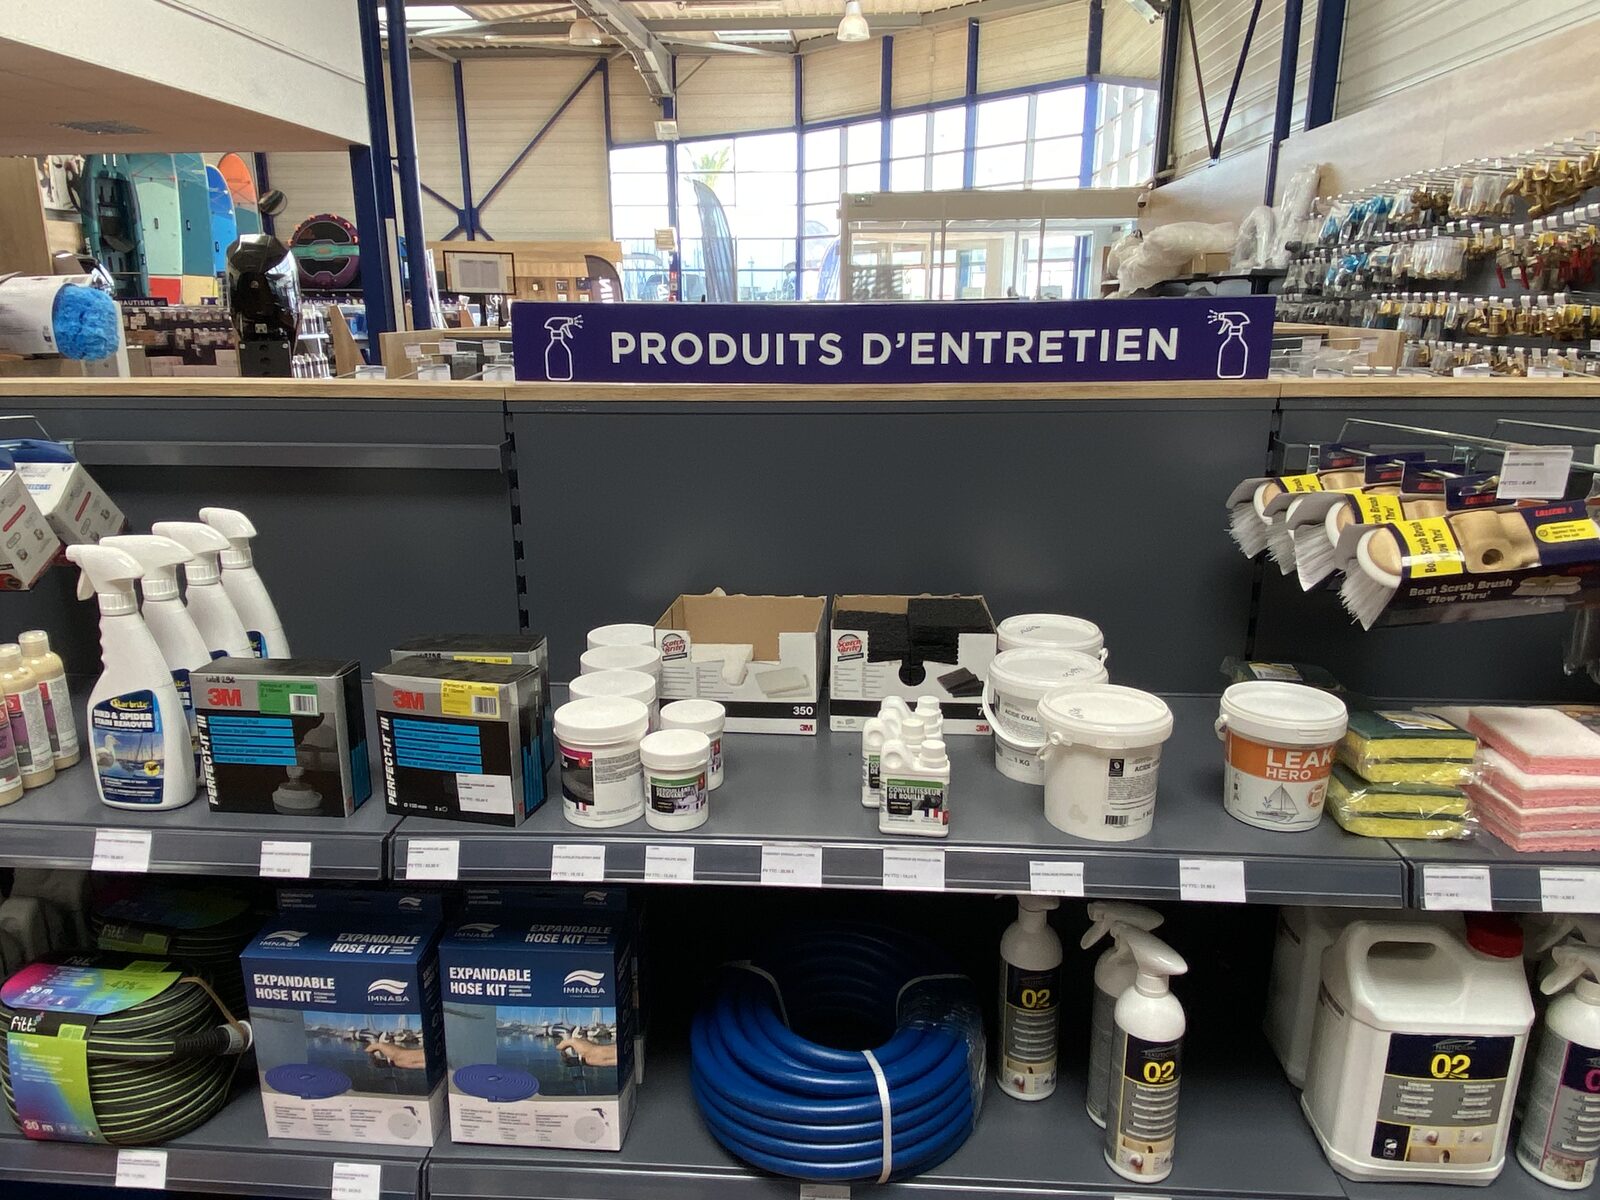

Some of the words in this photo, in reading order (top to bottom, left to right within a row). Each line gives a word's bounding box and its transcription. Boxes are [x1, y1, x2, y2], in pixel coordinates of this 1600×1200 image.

[610, 331, 842, 367] PRODUITS
[862, 327, 1180, 366] D'ENTRETIEN
[1409, 586, 1437, 597] Boat
[1440, 582, 1475, 593] Scrub
[1477, 578, 1513, 589] Brush
[208, 687, 242, 707] 3M
[393, 690, 425, 711] 3M
[119, 712, 152, 720] SPIDER
[793, 706, 813, 715] 350
[113, 720, 153, 728] REMOVER
[976, 724, 989, 732] 3M
[199, 728, 219, 806] PERFECT-IT
[382, 732, 398, 806] PERFECT-IT
[1019, 759, 1030, 767] KG
[1266, 767, 1311, 780] HERO
[888, 787, 941, 796] CONVERTISSEUR
[529, 923, 612, 935] EXPANDABLE
[337, 932, 421, 945] EXPANDABLE
[525, 933, 559, 943] HOSE
[562, 934, 585, 944] KIT
[329, 943, 365, 954] HOSE
[366, 943, 391, 954] KIT
[449, 966, 531, 982] EXPANDABLE
[253, 973, 335, 990] EXPANDABLE
[255, 987, 289, 1001] HOSE
[291, 990, 312, 1002] KIT
[450, 981, 483, 996] HOSE
[486, 983, 507, 997] KIT
[563, 986, 606, 994] IMNASA
[367, 994, 410, 1002] IMNASA
[1021, 988, 1051, 1009] 02
[1143, 1060, 1175, 1083] 02
[1431, 1053, 1471, 1079] 02
[23, 1119, 40, 1131] 30
[41, 1123, 54, 1132] m
